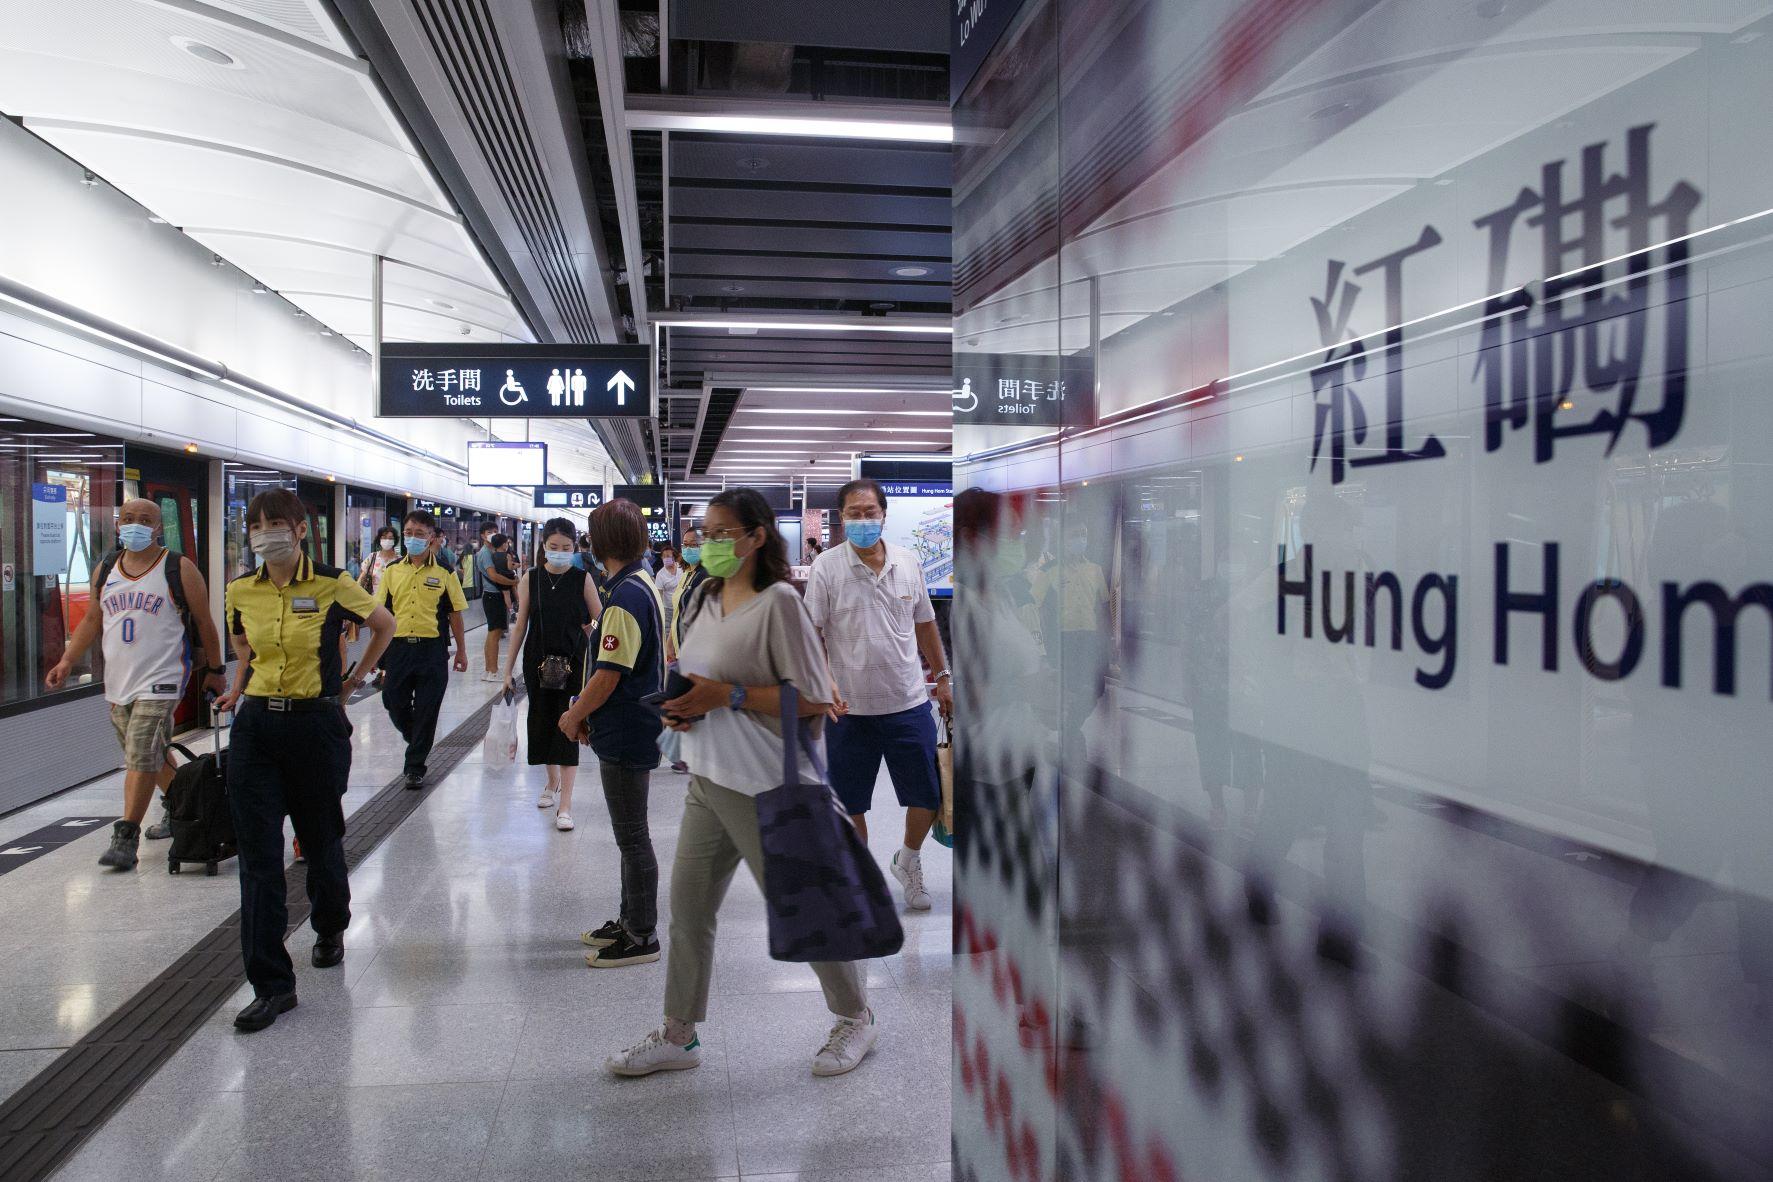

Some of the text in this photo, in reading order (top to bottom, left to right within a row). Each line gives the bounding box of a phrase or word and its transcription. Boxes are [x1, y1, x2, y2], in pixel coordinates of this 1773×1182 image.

[960, 19, 970, 47] Lo
[1308, 122, 1704, 486] 紅磡
[412, 368, 481, 391] 洗手間
[444, 394, 481, 406] Toilets
[103, 592, 165, 618] THUNDER
[1278, 540, 1458, 689] Hung
[122, 617, 135, 645] 0
